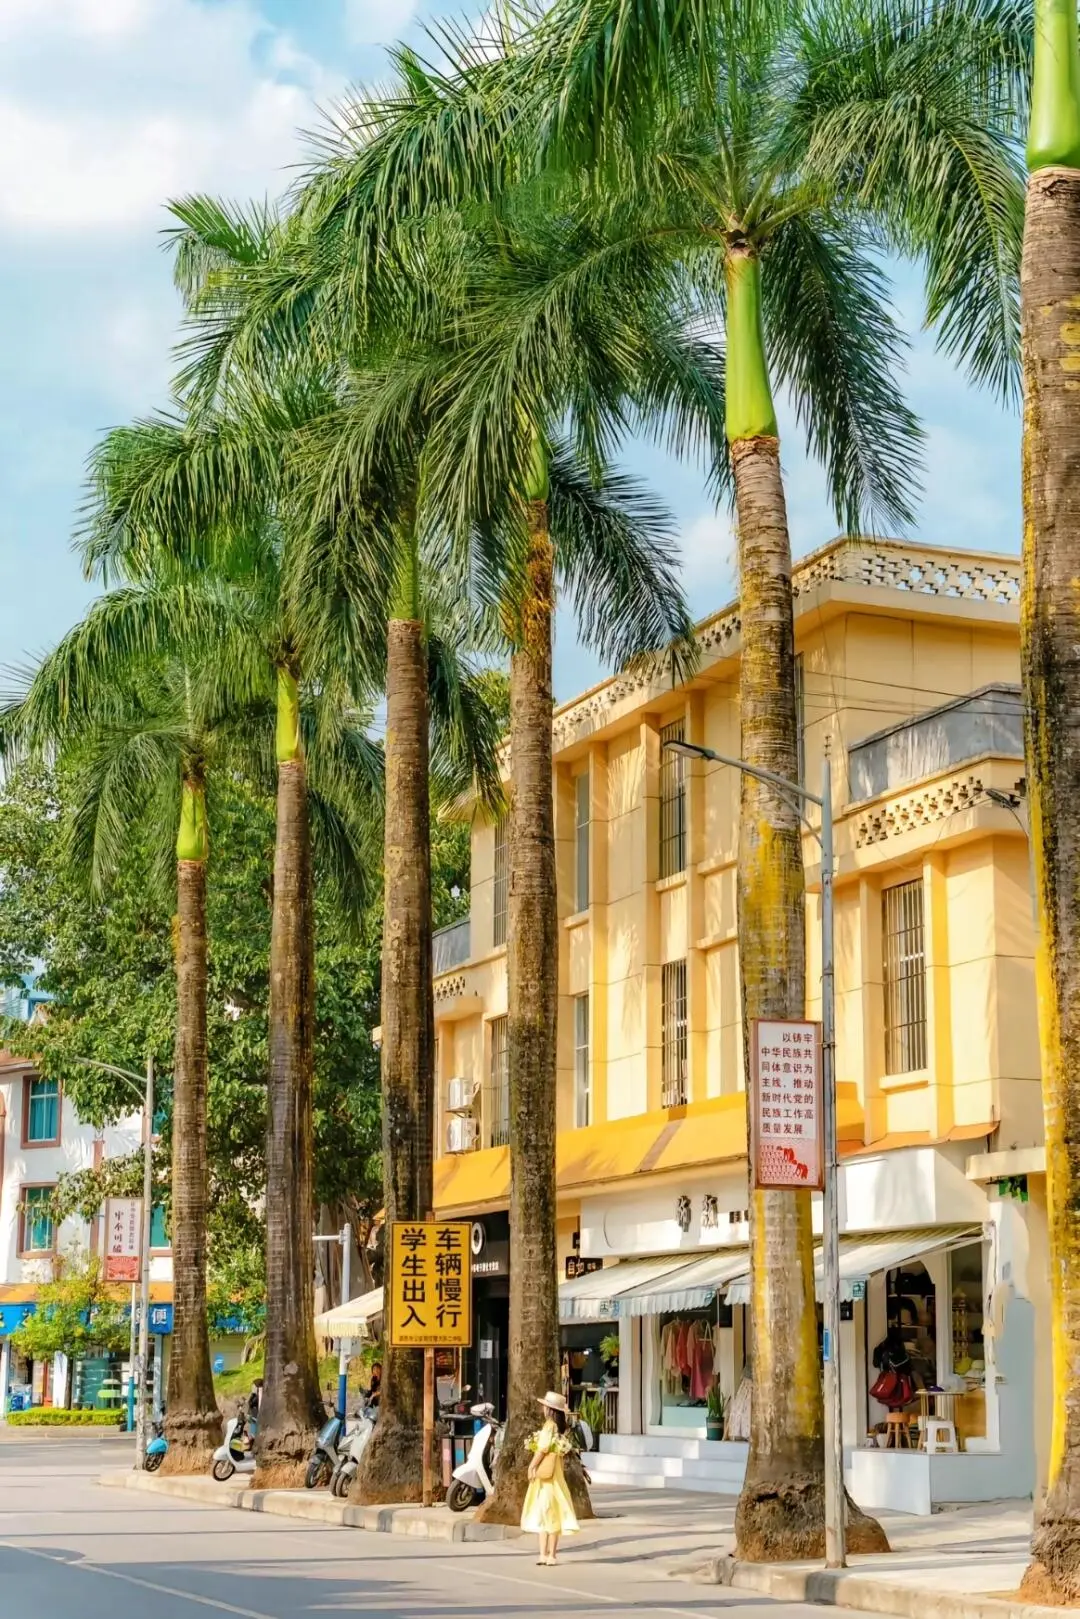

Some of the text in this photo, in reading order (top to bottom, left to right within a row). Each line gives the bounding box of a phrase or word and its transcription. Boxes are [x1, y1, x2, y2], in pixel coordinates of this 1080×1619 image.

[761, 1046, 813, 1058] 中华民族共
[761, 1060, 813, 1074] 同体意识为
[761, 1091, 814, 1105] 新时代党的
[762, 1107, 814, 1119] 民族工作高
[400, 1228, 427, 1328] 学生出入
[435, 1228, 462, 1328] 车辆慢行
